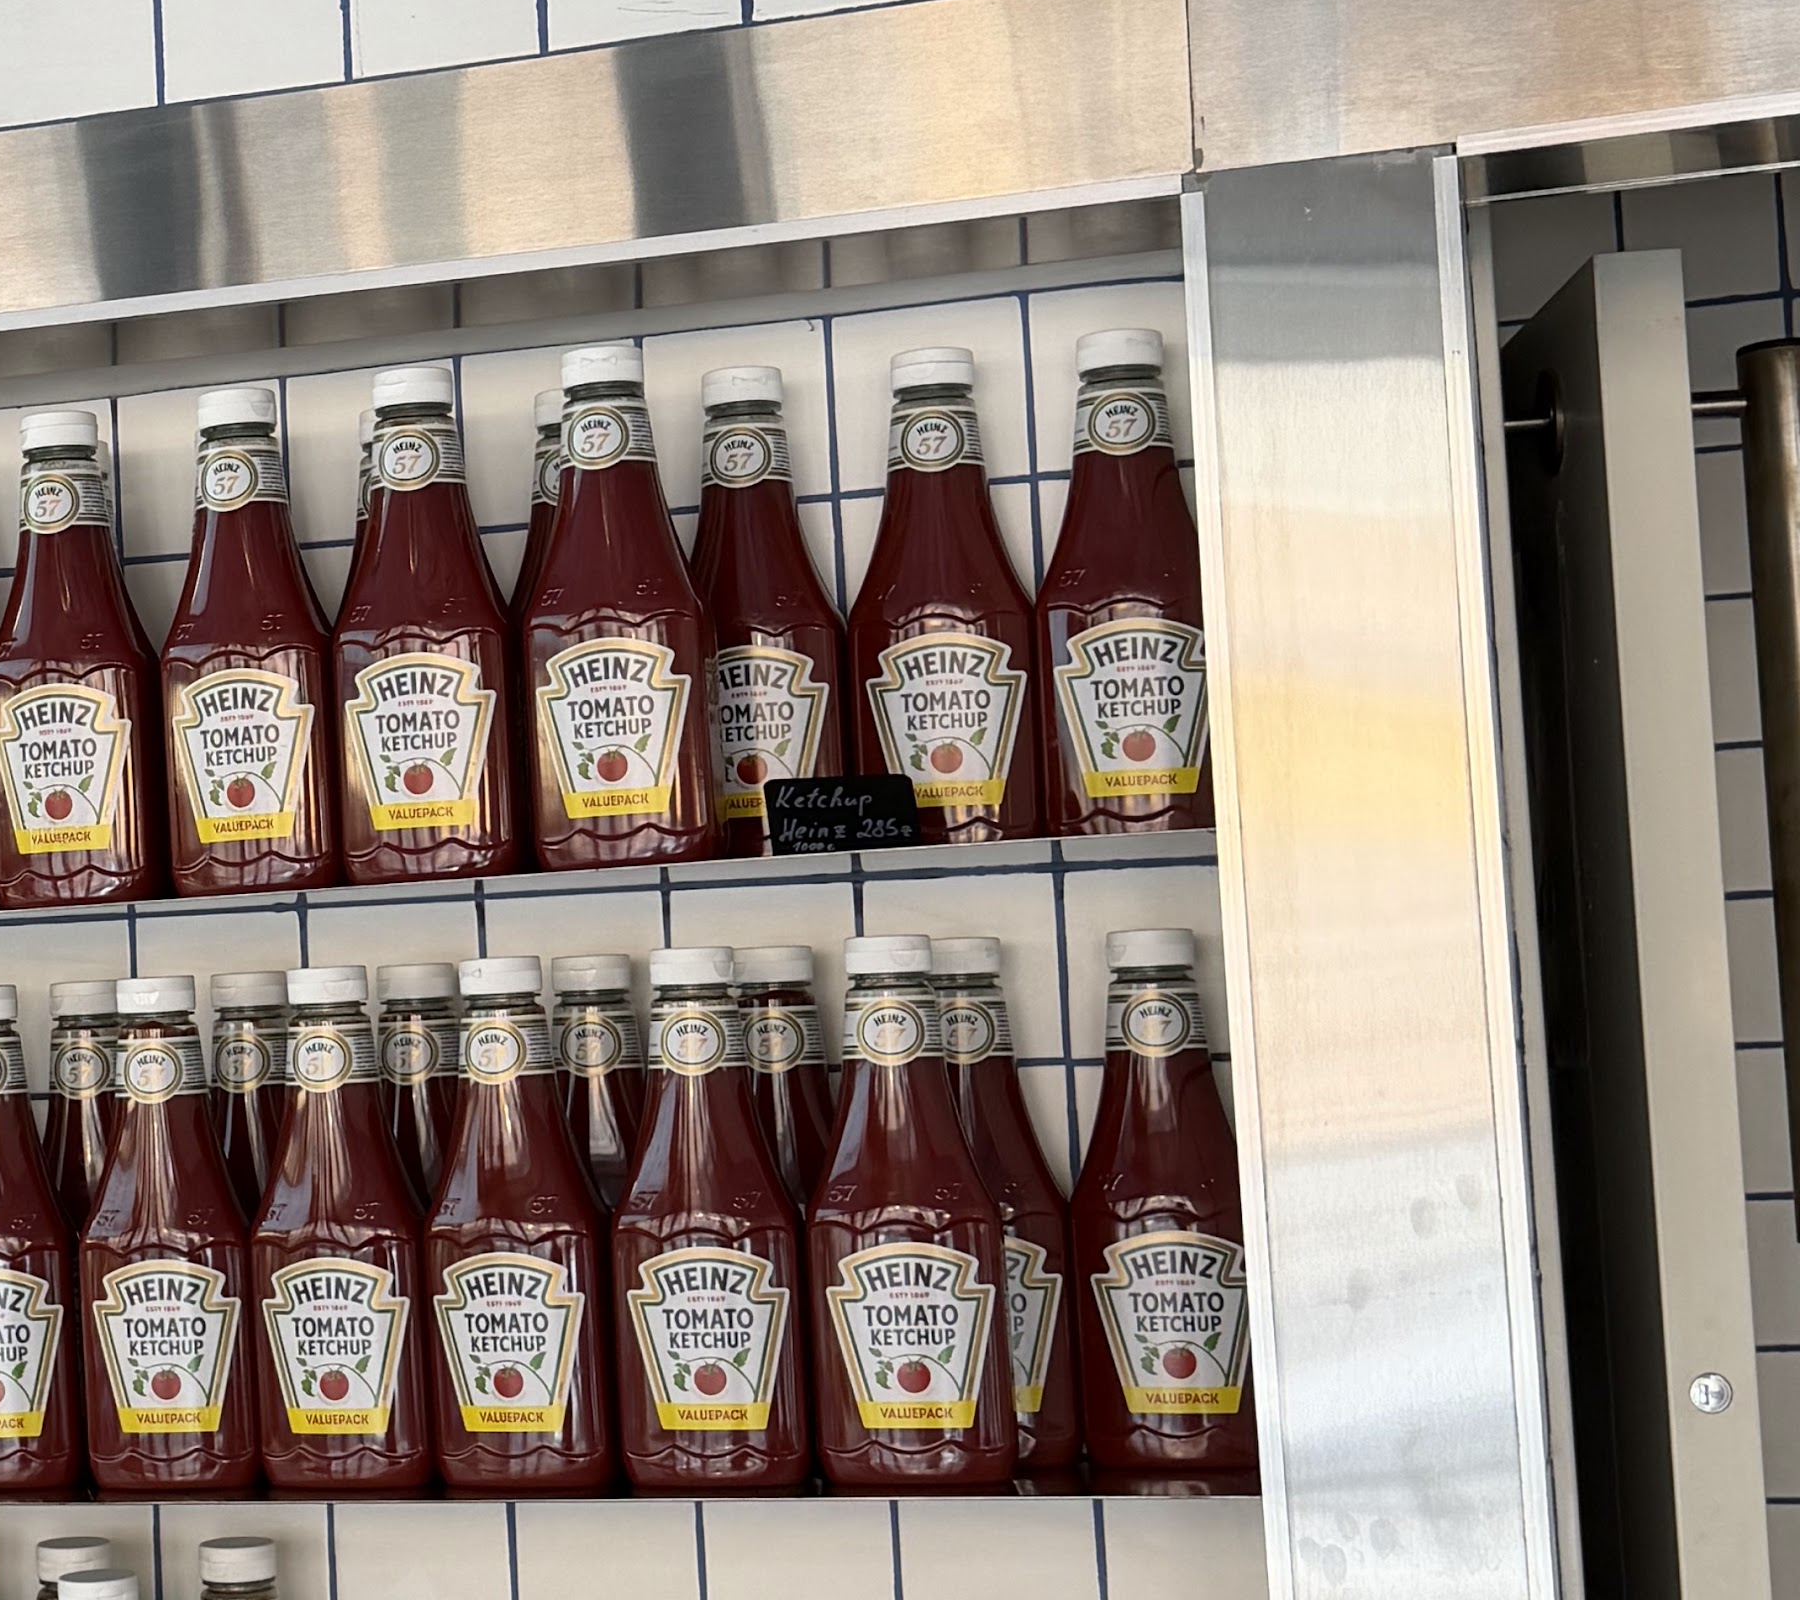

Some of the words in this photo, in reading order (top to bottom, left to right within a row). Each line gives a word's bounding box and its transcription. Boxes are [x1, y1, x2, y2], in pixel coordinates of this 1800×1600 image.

[1106, 418, 1138, 438] 57
[916, 435, 947, 455] 57
[392, 454, 422, 475] 57
[1092, 636, 1179, 668] HEINZ
[568, 656, 648, 688] HEINZ
[902, 651, 985, 681] HEINZ
[376, 671, 454, 702] HEINZ
[1090, 675, 1185, 701] TOMATO
[201, 687, 273, 717] HEINZ
[566, 695, 654, 722] TOMATO
[900, 689, 991, 713] TOMATO
[1098, 698, 1182, 719] KETCHUP
[20, 701, 91, 731] HEINZ
[375, 710, 460, 734] TOMATO
[907, 711, 988, 732] KETCHUP
[200, 724, 280, 750] TOMATO
[574, 718, 652, 740] KETCHUP
[19, 738, 97, 762] TOMATO
[381, 732, 457, 752] KETCHUP
[206, 746, 277, 767] KETCHUP
[24, 760, 94, 779] KETCHUP
[1104, 774, 1178, 789] VALUEPACK
[582, 793, 649, 808] VALUEPACK
[775, 785, 873, 816] Ketchup
[388, 806, 454, 820] VALUEPACK
[778, 818, 847, 842] Heinz
[1130, 1250, 1218, 1280] HEINZ
[465, 1272, 542, 1301] HEINZ
[663, 1266, 747, 1296] HEINZ
[864, 1262, 952, 1292] HEINZ
[124, 1278, 201, 1306] HEINZ
[292, 1276, 368, 1305] HEINZ
[1128, 1291, 1225, 1313] TOMATO
[464, 1312, 548, 1334] TOMATO
[662, 1308, 754, 1330] TOMATO
[862, 1304, 959, 1327] TOMATO
[1136, 1315, 1222, 1332] KETCHUP
[123, 1316, 206, 1338] TOMATO
[291, 1316, 374, 1338] TOMATO
[870, 1328, 956, 1346] KETCHUP
[129, 1339, 204, 1356] KETCHUP
[298, 1339, 372, 1356] KETCHUP
[471, 1335, 546, 1352] KETCHUP
[669, 1331, 751, 1349] KETCHUP
[136, 1412, 201, 1424] VALUEPACK
[678, 1409, 748, 1421] VALUEPACK
[880, 1407, 953, 1419] VALUEPACK
